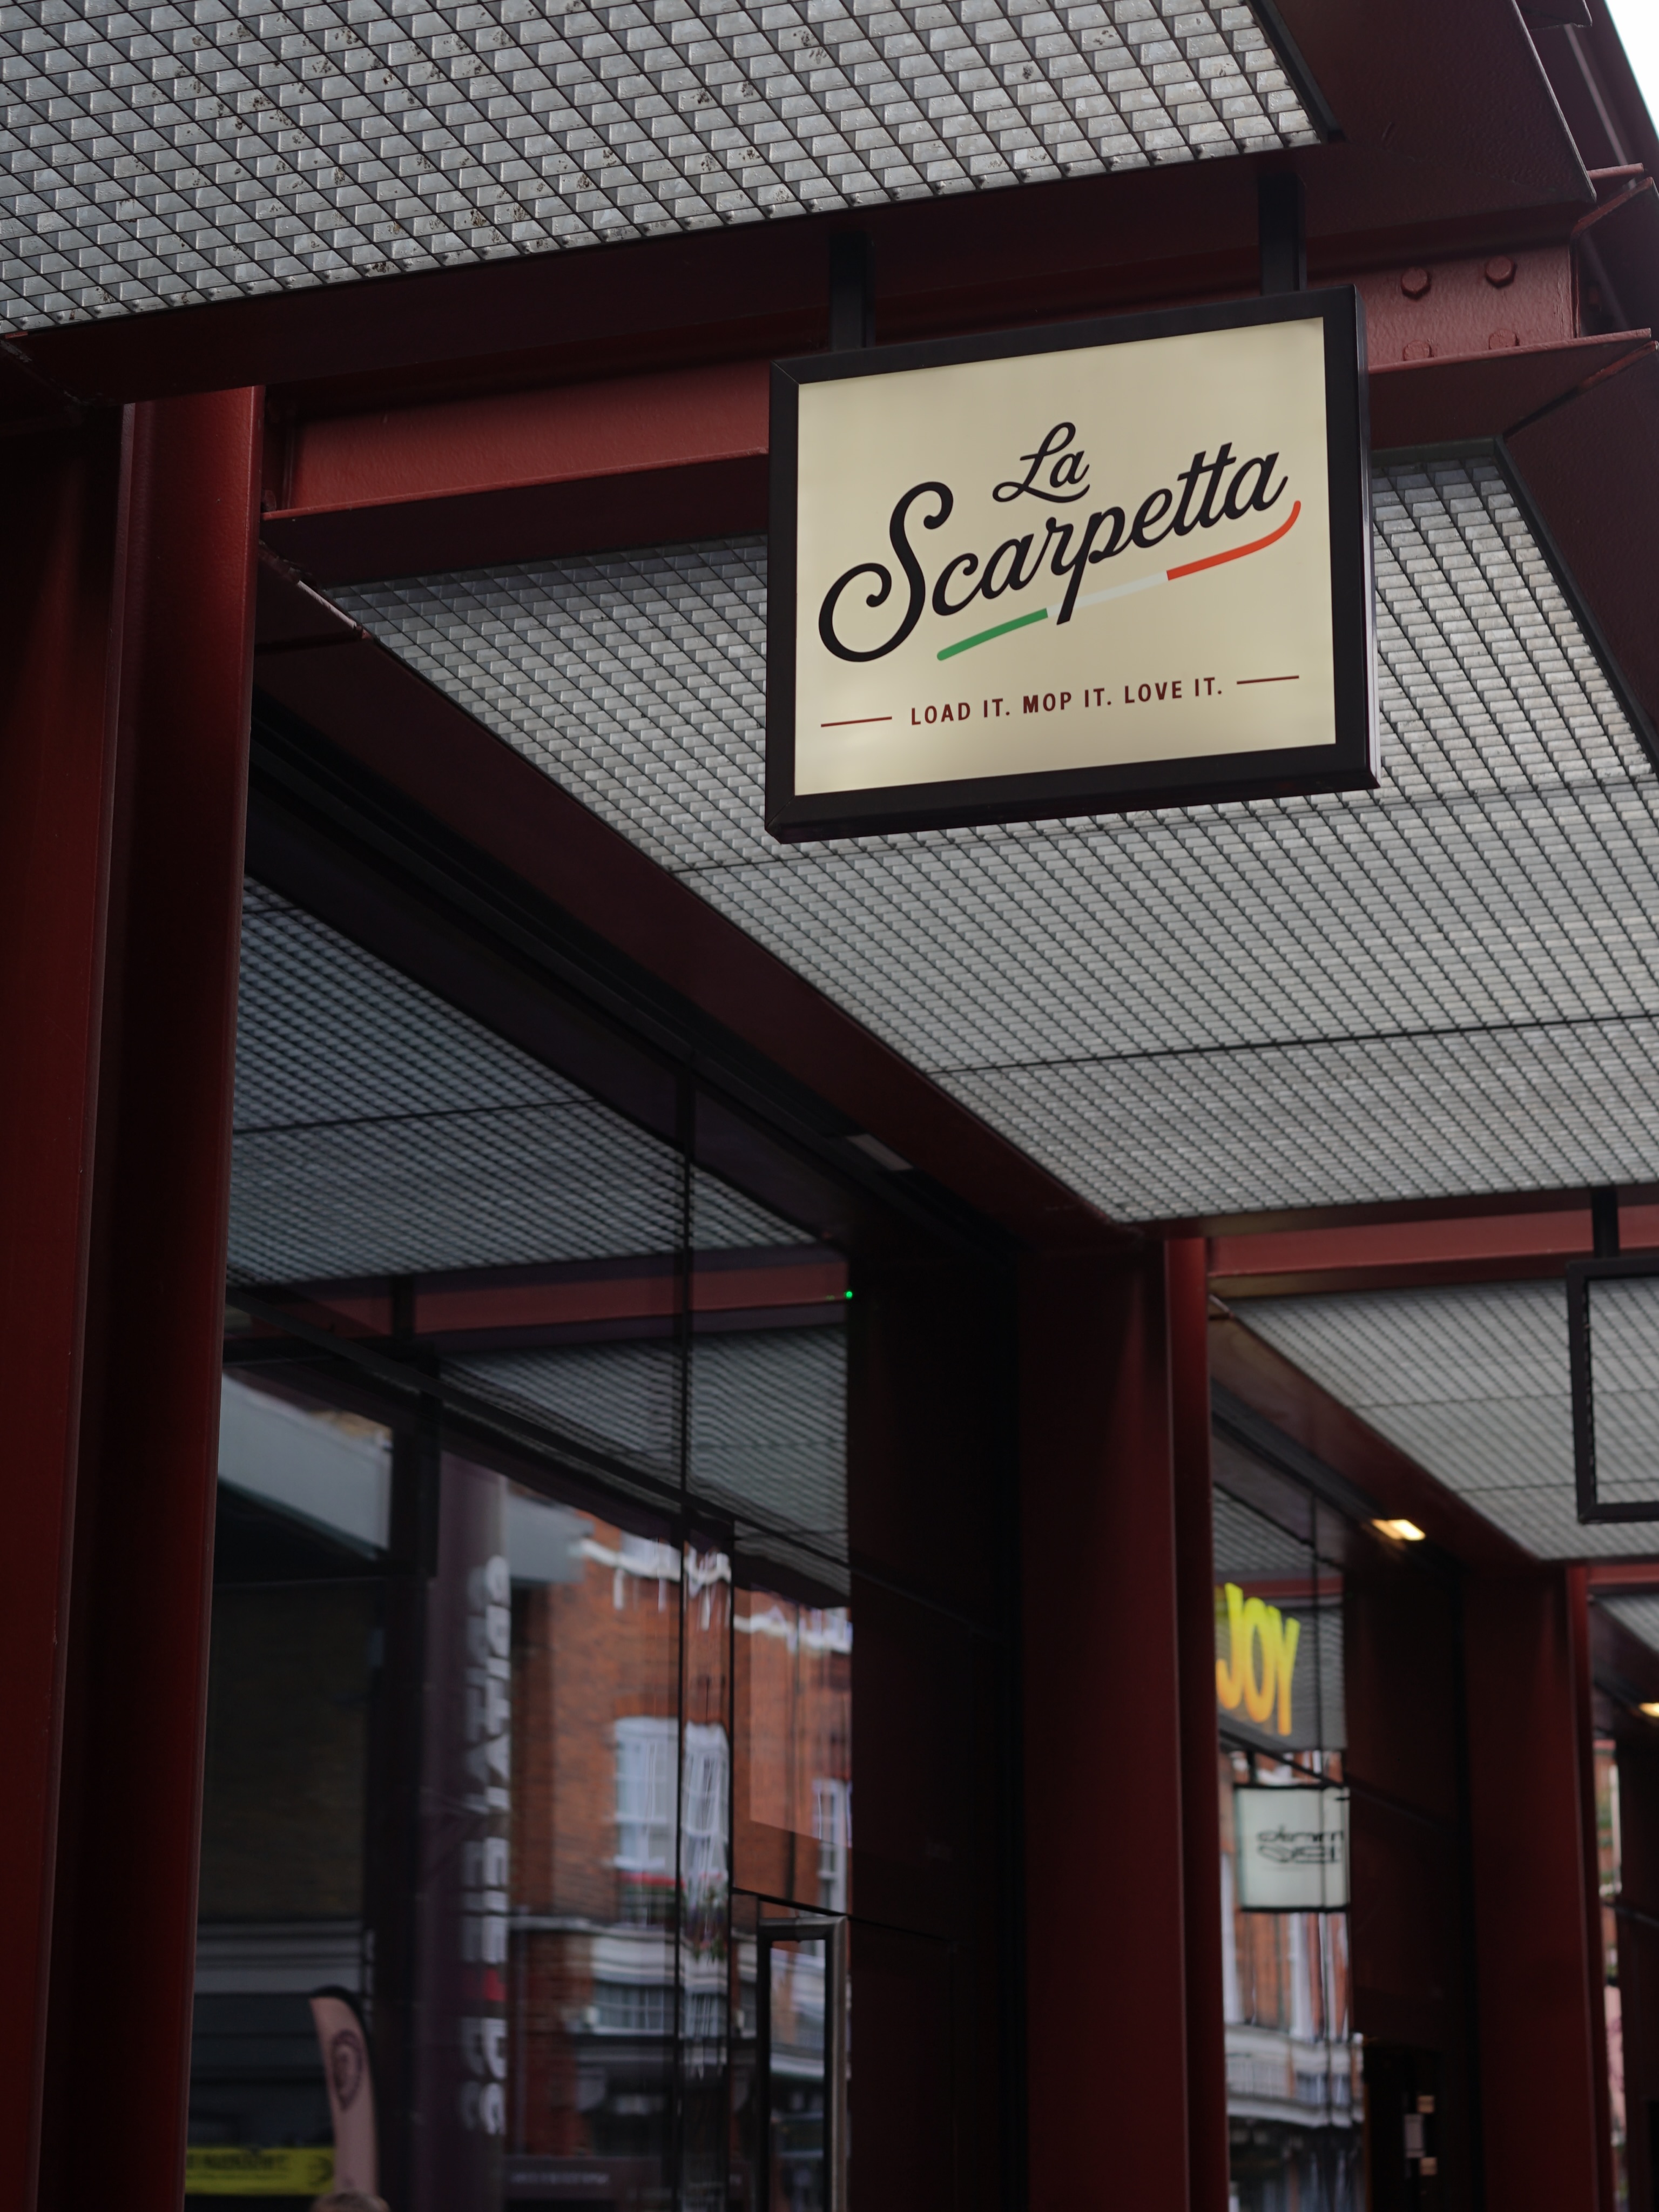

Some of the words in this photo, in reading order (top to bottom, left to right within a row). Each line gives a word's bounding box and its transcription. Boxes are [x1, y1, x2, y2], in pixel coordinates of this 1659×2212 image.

[992, 421, 1091, 504] La
[818, 442, 1289, 663] Scarpetta
[911, 702, 972, 726] LOAD
[983, 697, 1010, 718] IT.
[1022, 691, 1073, 714] MOP
[1084, 687, 1112, 709] IT.
[1124, 680, 1183, 704] LOVE
[1194, 676, 1223, 697] IT.
[1216, 1582, 1300, 1736] JOY
